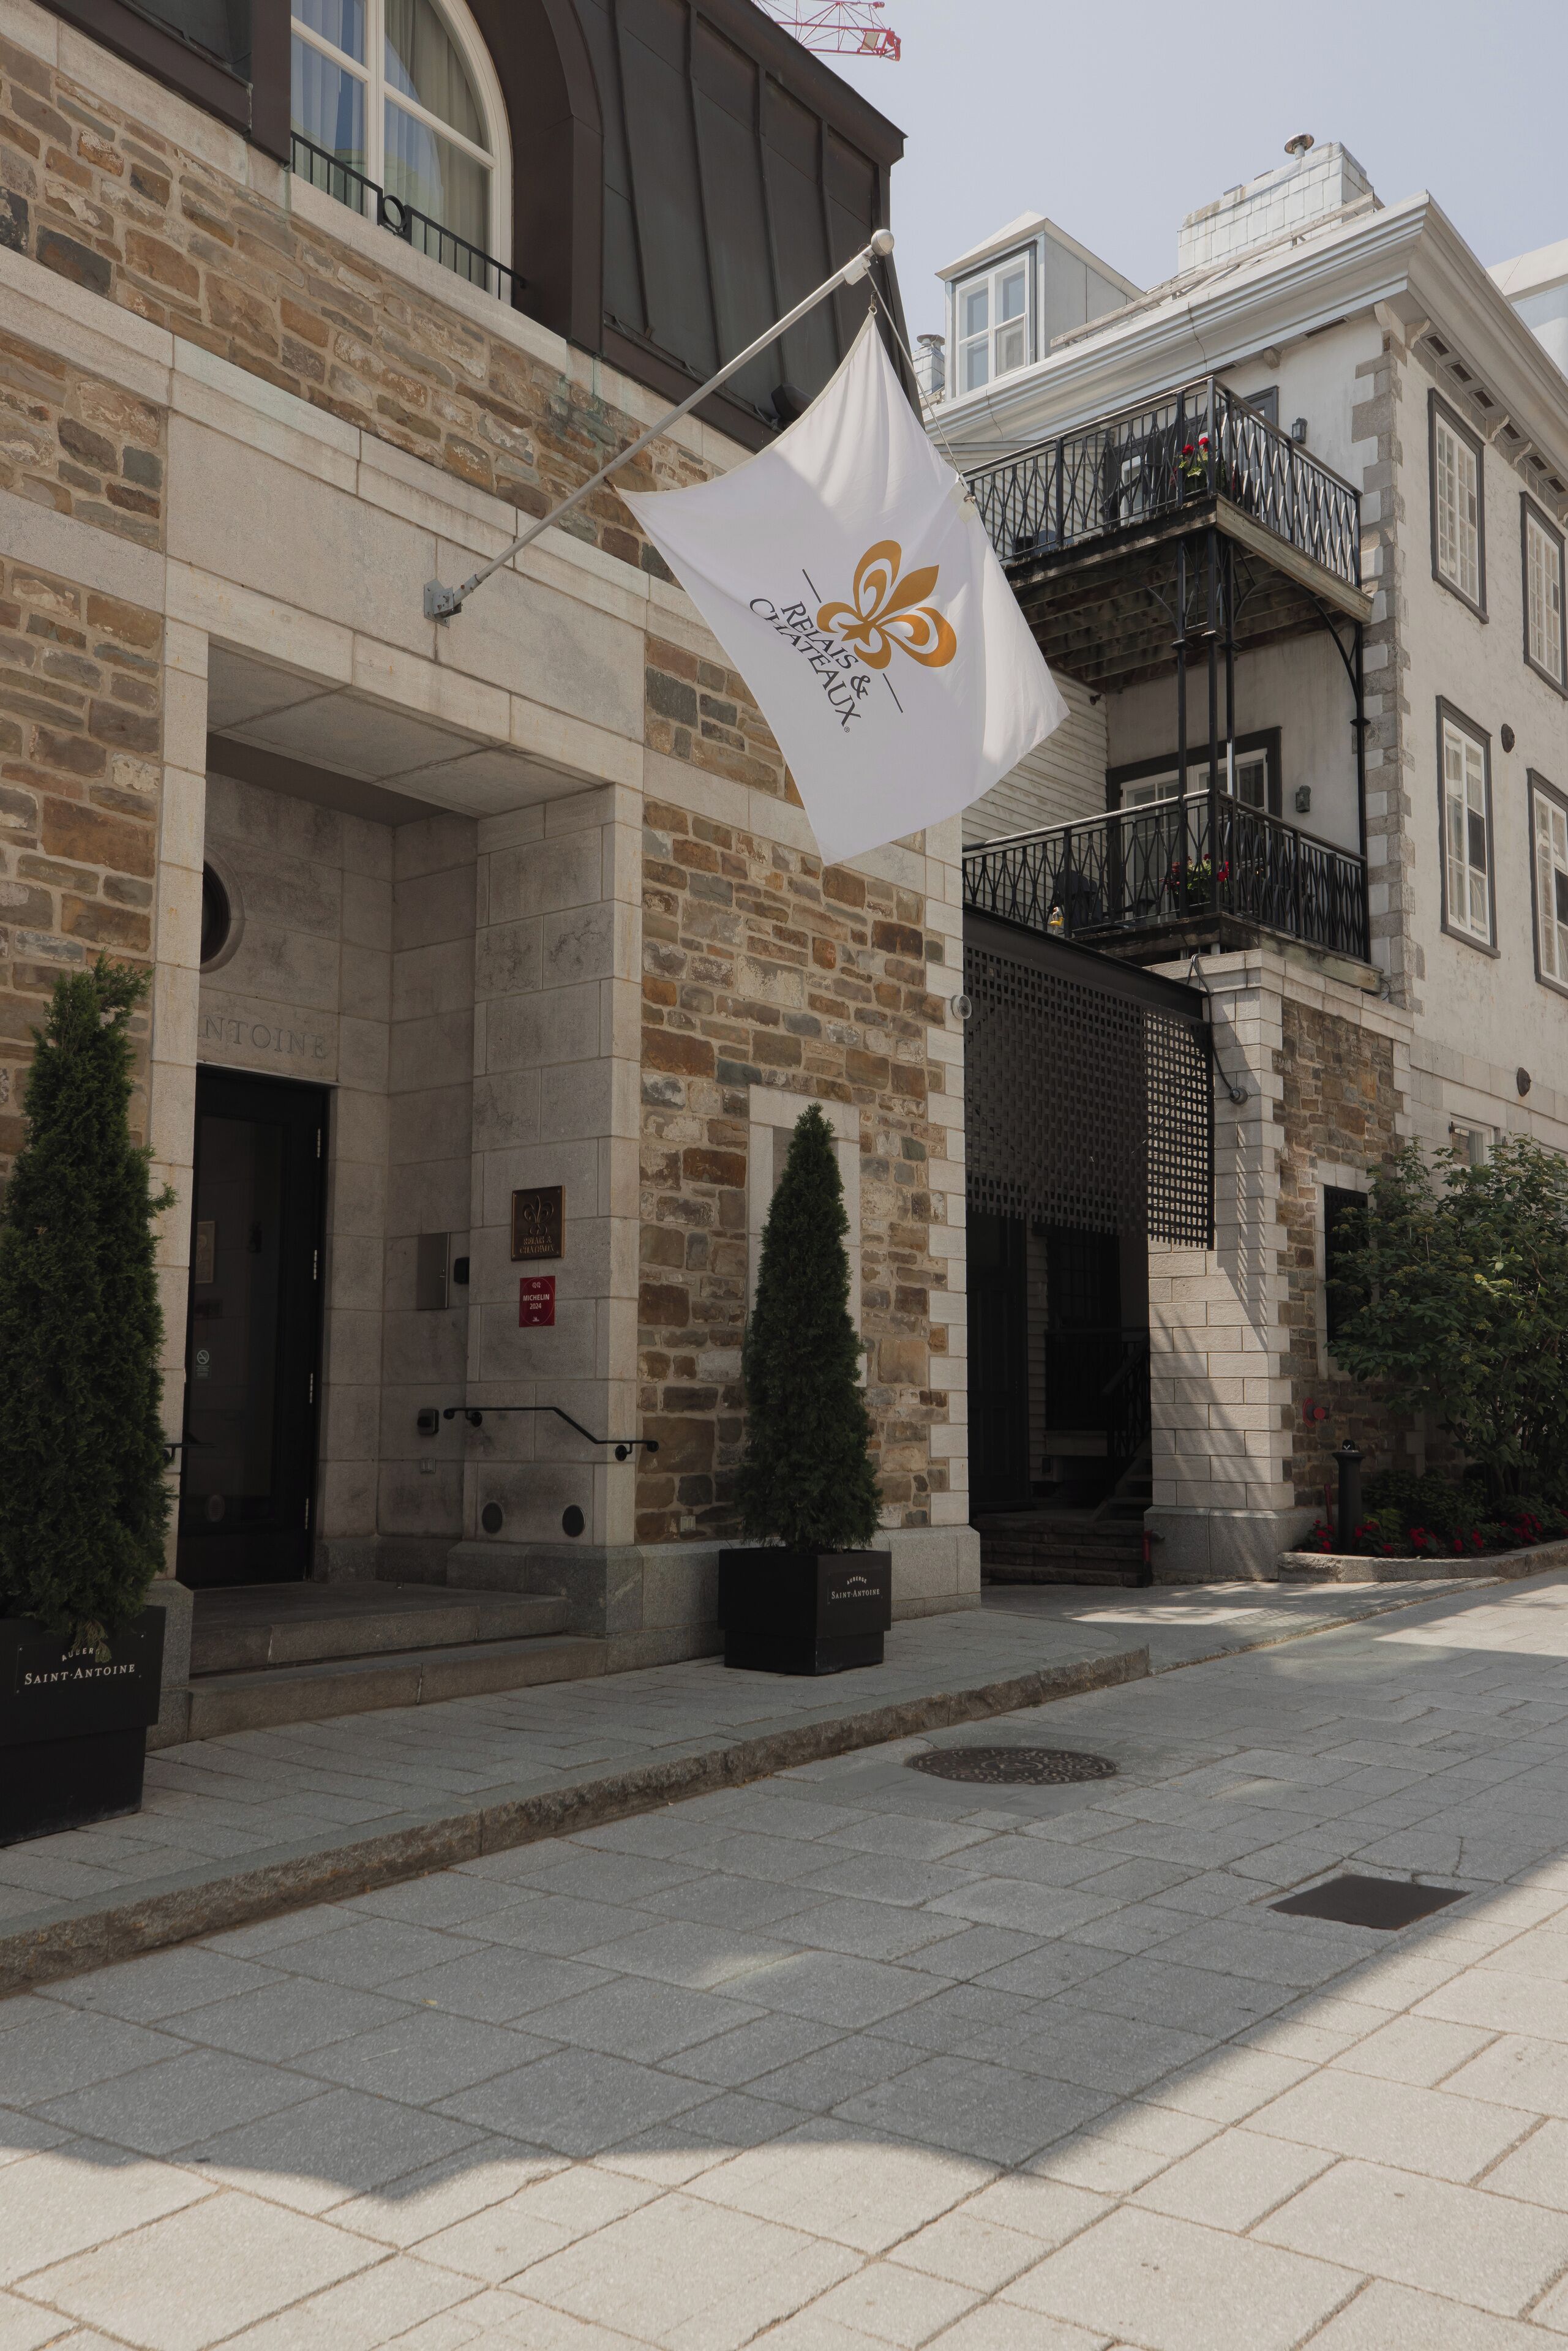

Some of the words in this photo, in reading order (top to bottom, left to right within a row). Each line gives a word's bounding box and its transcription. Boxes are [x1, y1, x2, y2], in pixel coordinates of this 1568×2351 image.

[781, 601, 859, 669] RELAIS
[850, 675, 871, 700] &
[198, 1014, 327, 1059] NTOINE
[847, 1576, 868, 1585] AUBERGE
